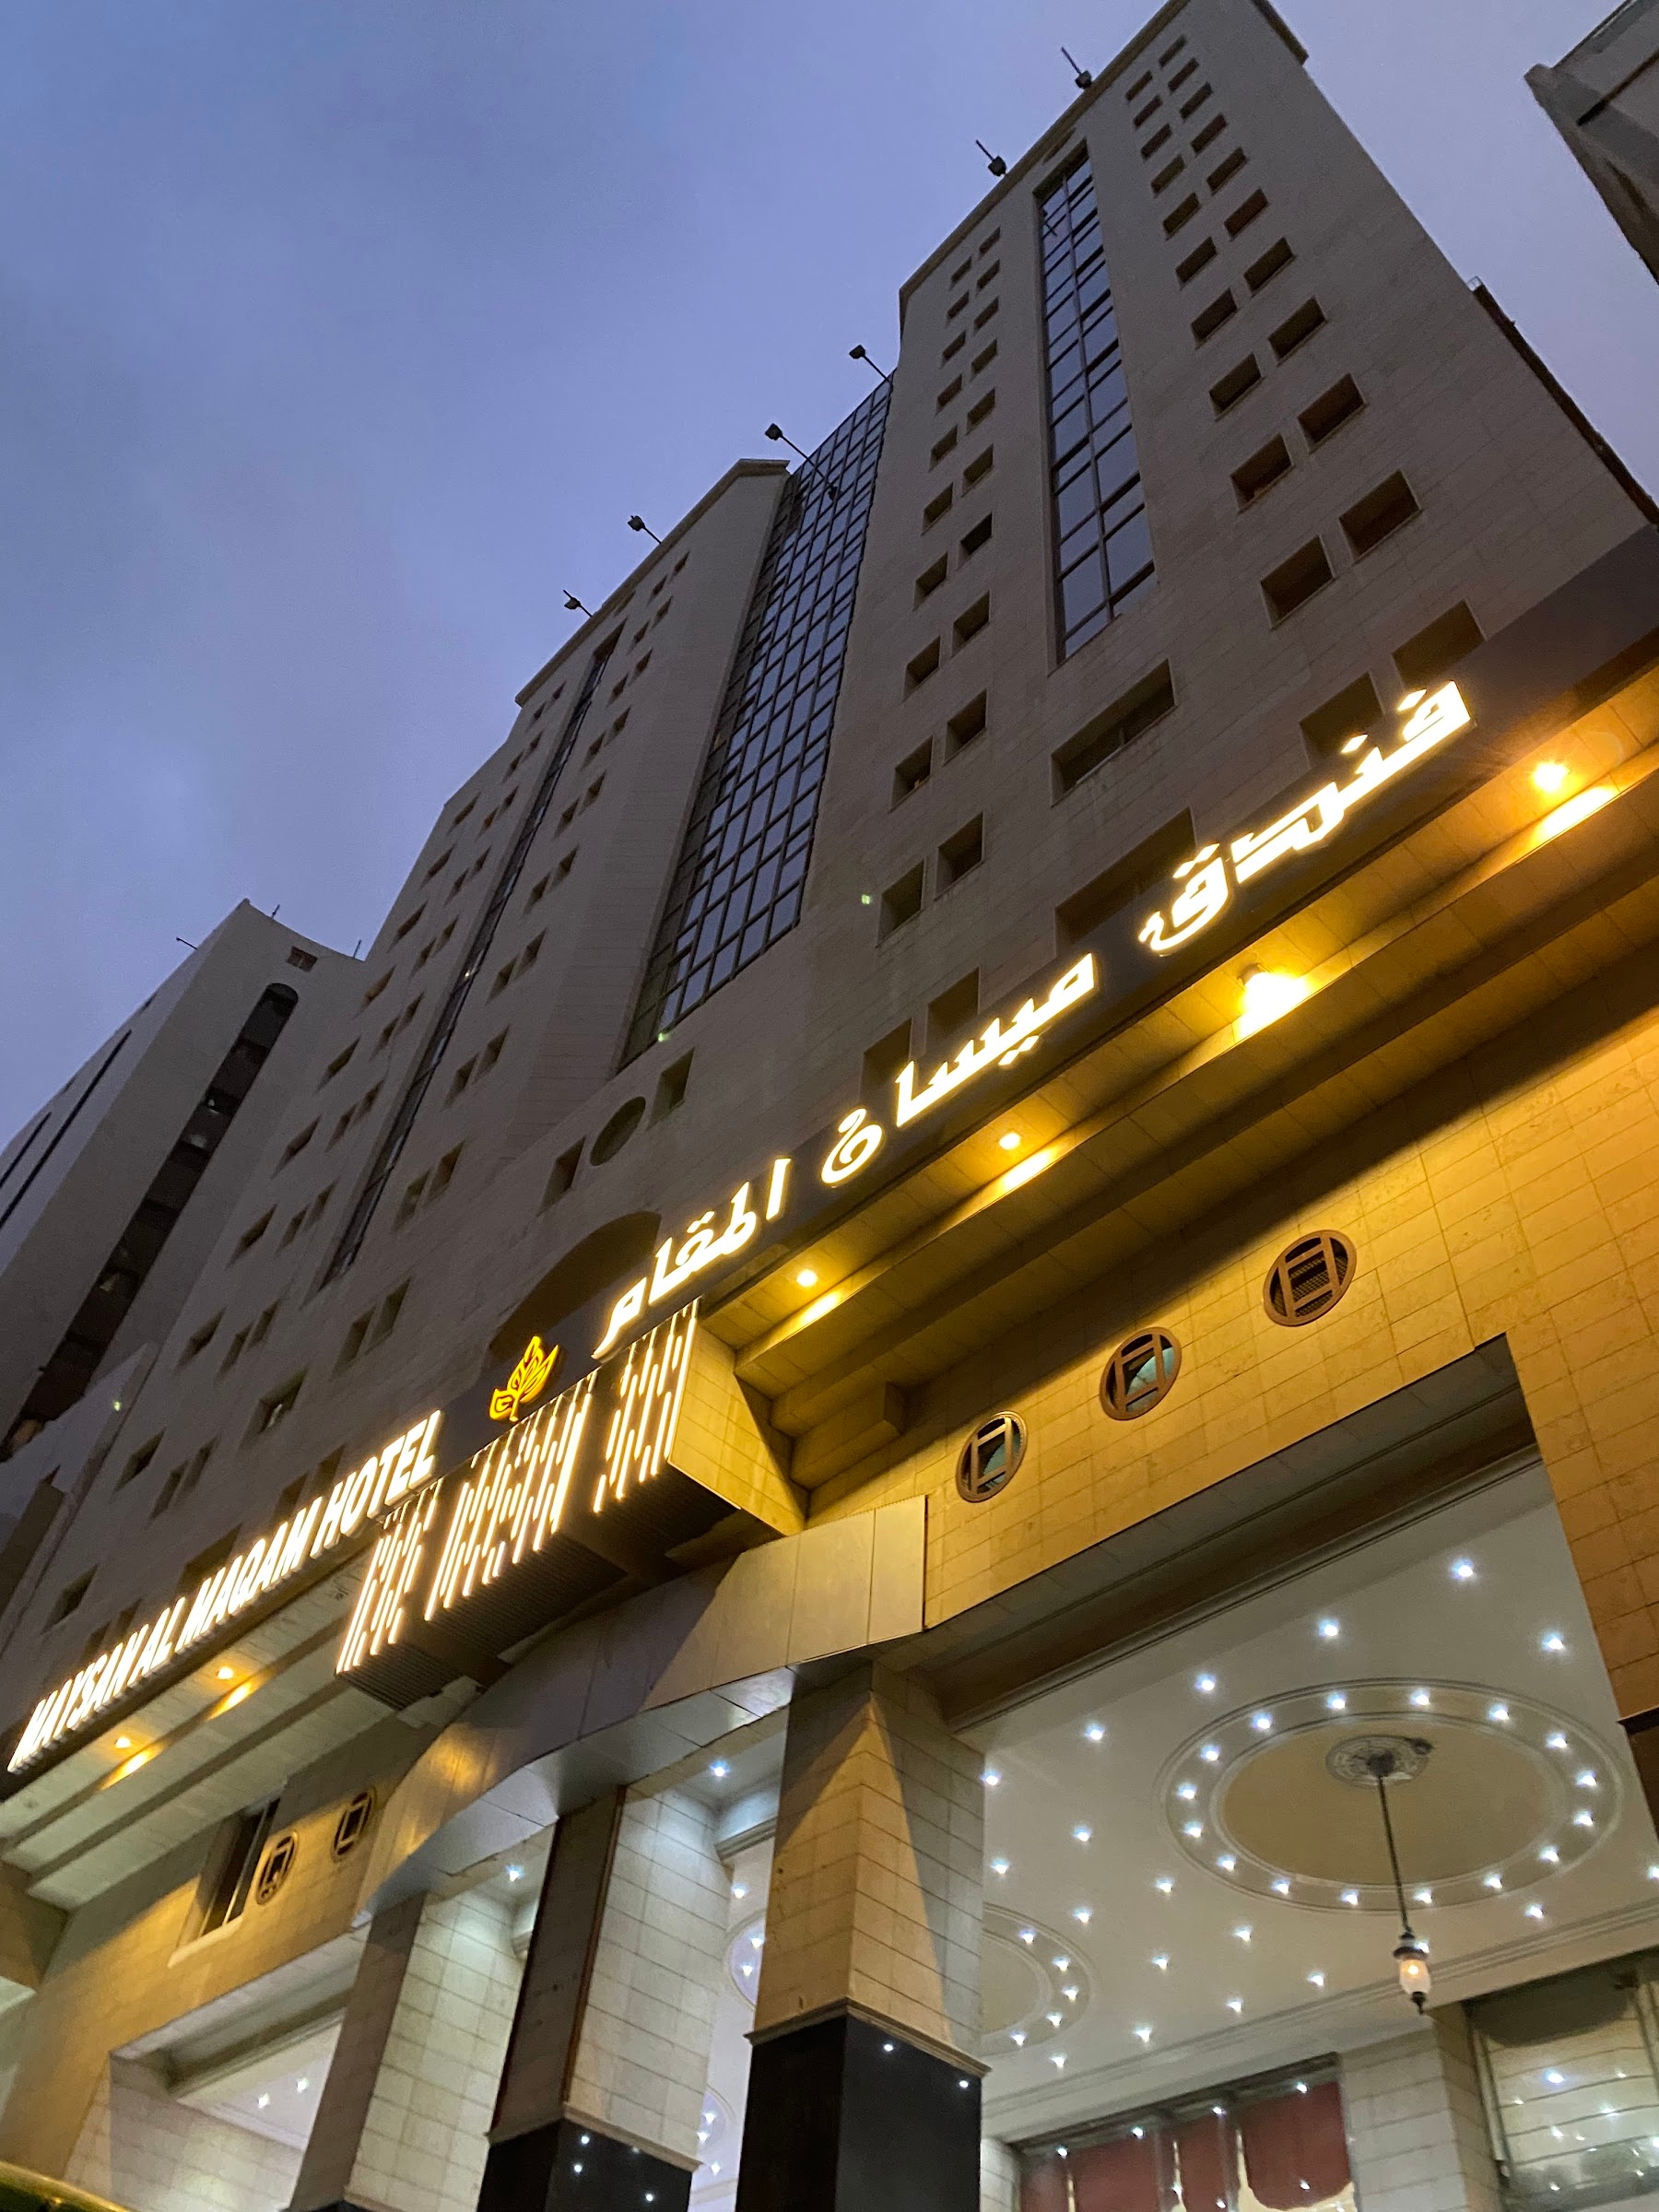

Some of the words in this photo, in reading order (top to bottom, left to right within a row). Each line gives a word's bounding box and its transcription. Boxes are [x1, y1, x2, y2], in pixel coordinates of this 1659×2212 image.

[1139, 680, 1472, 954] فندق
[821, 952, 1095, 1192] ميسان
[593, 1158, 791, 1359] المقام
[7, 1624, 149, 1773] MAYSAN
[127, 1596, 186, 1687] AL
[175, 1496, 323, 1653] MAQAM
[310, 1409, 441, 1558] HOTEL
